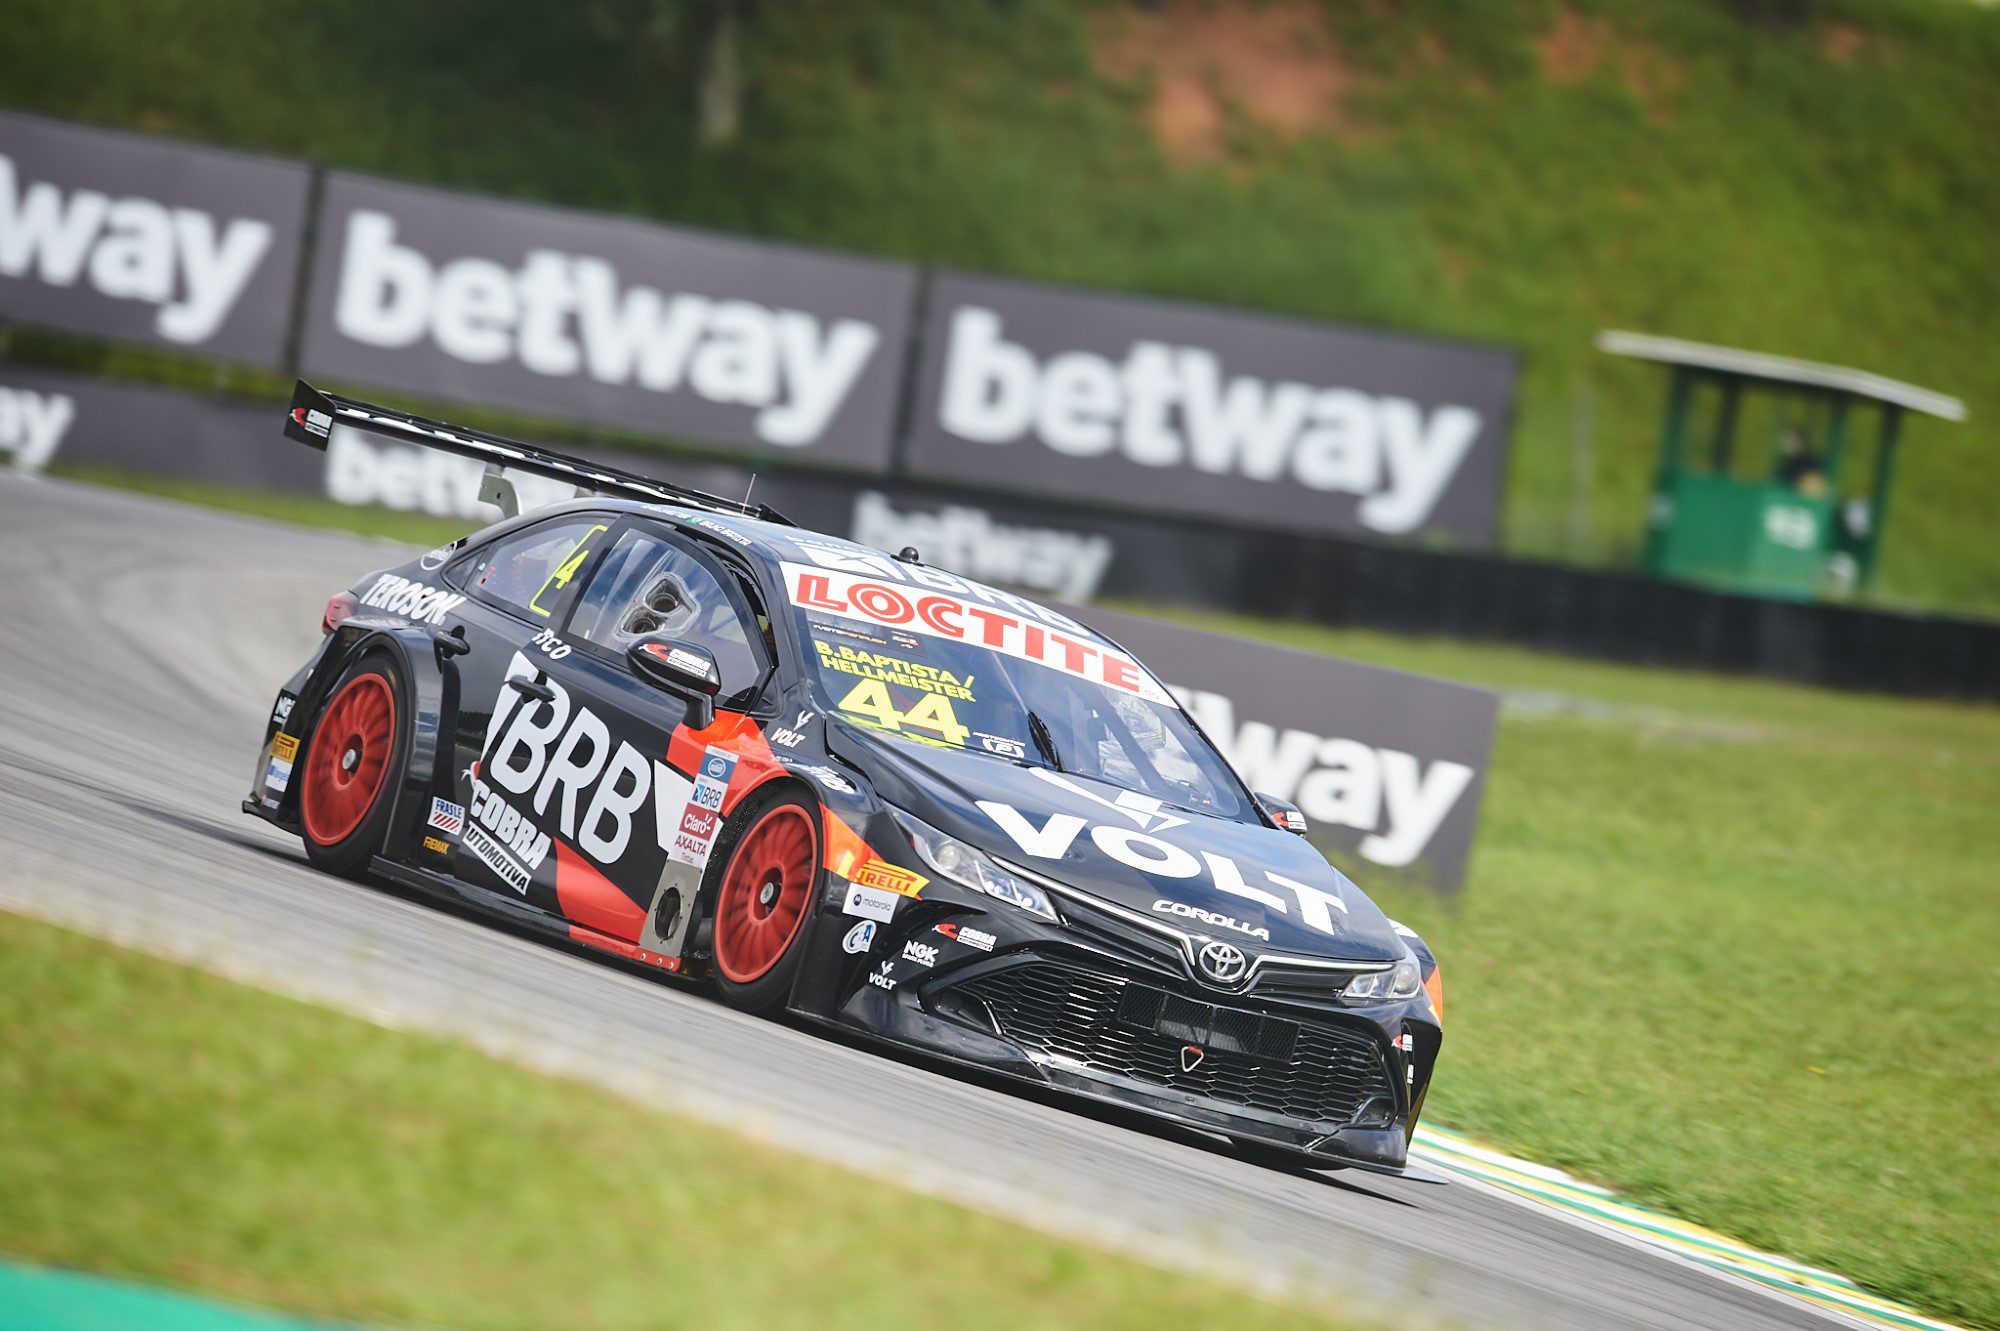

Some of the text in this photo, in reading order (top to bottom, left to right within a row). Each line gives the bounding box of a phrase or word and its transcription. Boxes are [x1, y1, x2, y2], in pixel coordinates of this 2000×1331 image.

[333, 208, 880, 448] betway
[938, 304, 1482, 535] betway
[796, 573, 1140, 693] LOCTITE
[821, 656, 976, 702] HELLMEISTER
[838, 677, 970, 750] 44
[770, 727, 806, 747] VOLT
[490, 675, 652, 865] BRB
[700, 787, 722, 809] BRB
[470, 778, 552, 871] COBRA
[674, 835, 707, 857] AXALTA
[684, 813, 707, 835] Claro
[974, 800, 1348, 935] VOLT
[861, 897, 891, 912] motorola
[1152, 898, 1270, 941] COROLLA
[904, 940, 939, 963] NGK
[868, 972, 897, 991] VOLT
